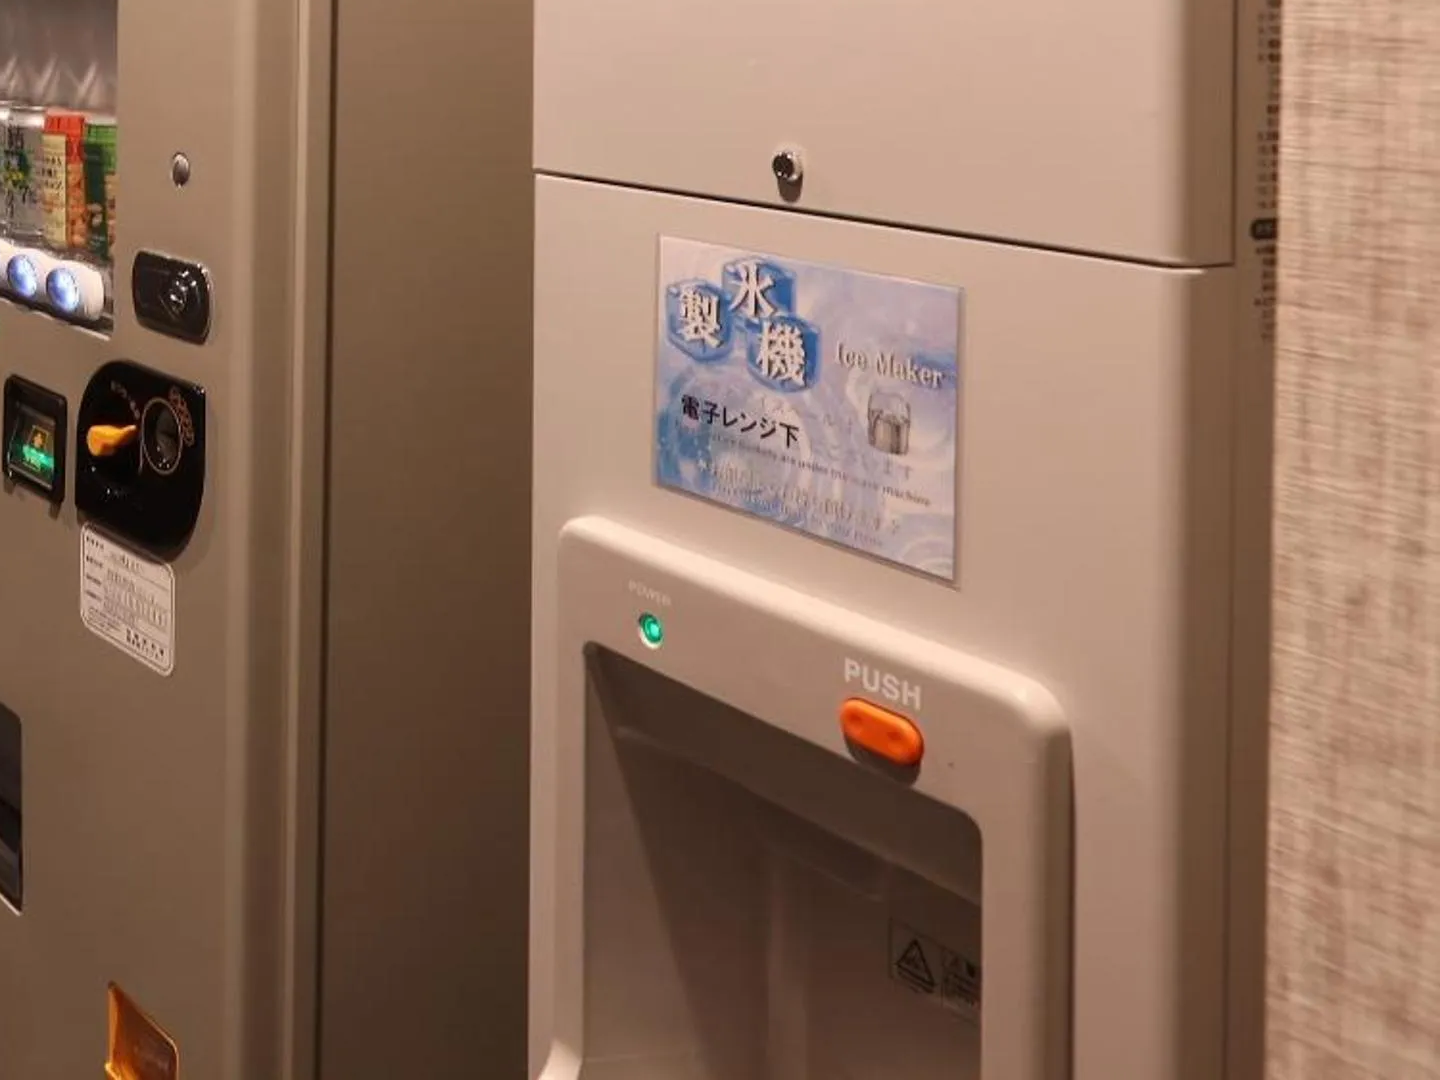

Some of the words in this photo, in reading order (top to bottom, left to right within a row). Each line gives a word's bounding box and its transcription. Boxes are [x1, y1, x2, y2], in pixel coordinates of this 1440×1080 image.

[676, 260, 807, 387] 製氷機
[875, 349, 946, 390] Maker
[681, 394, 799, 449] 電子レンジ下
[843, 657, 922, 710] PUSH
